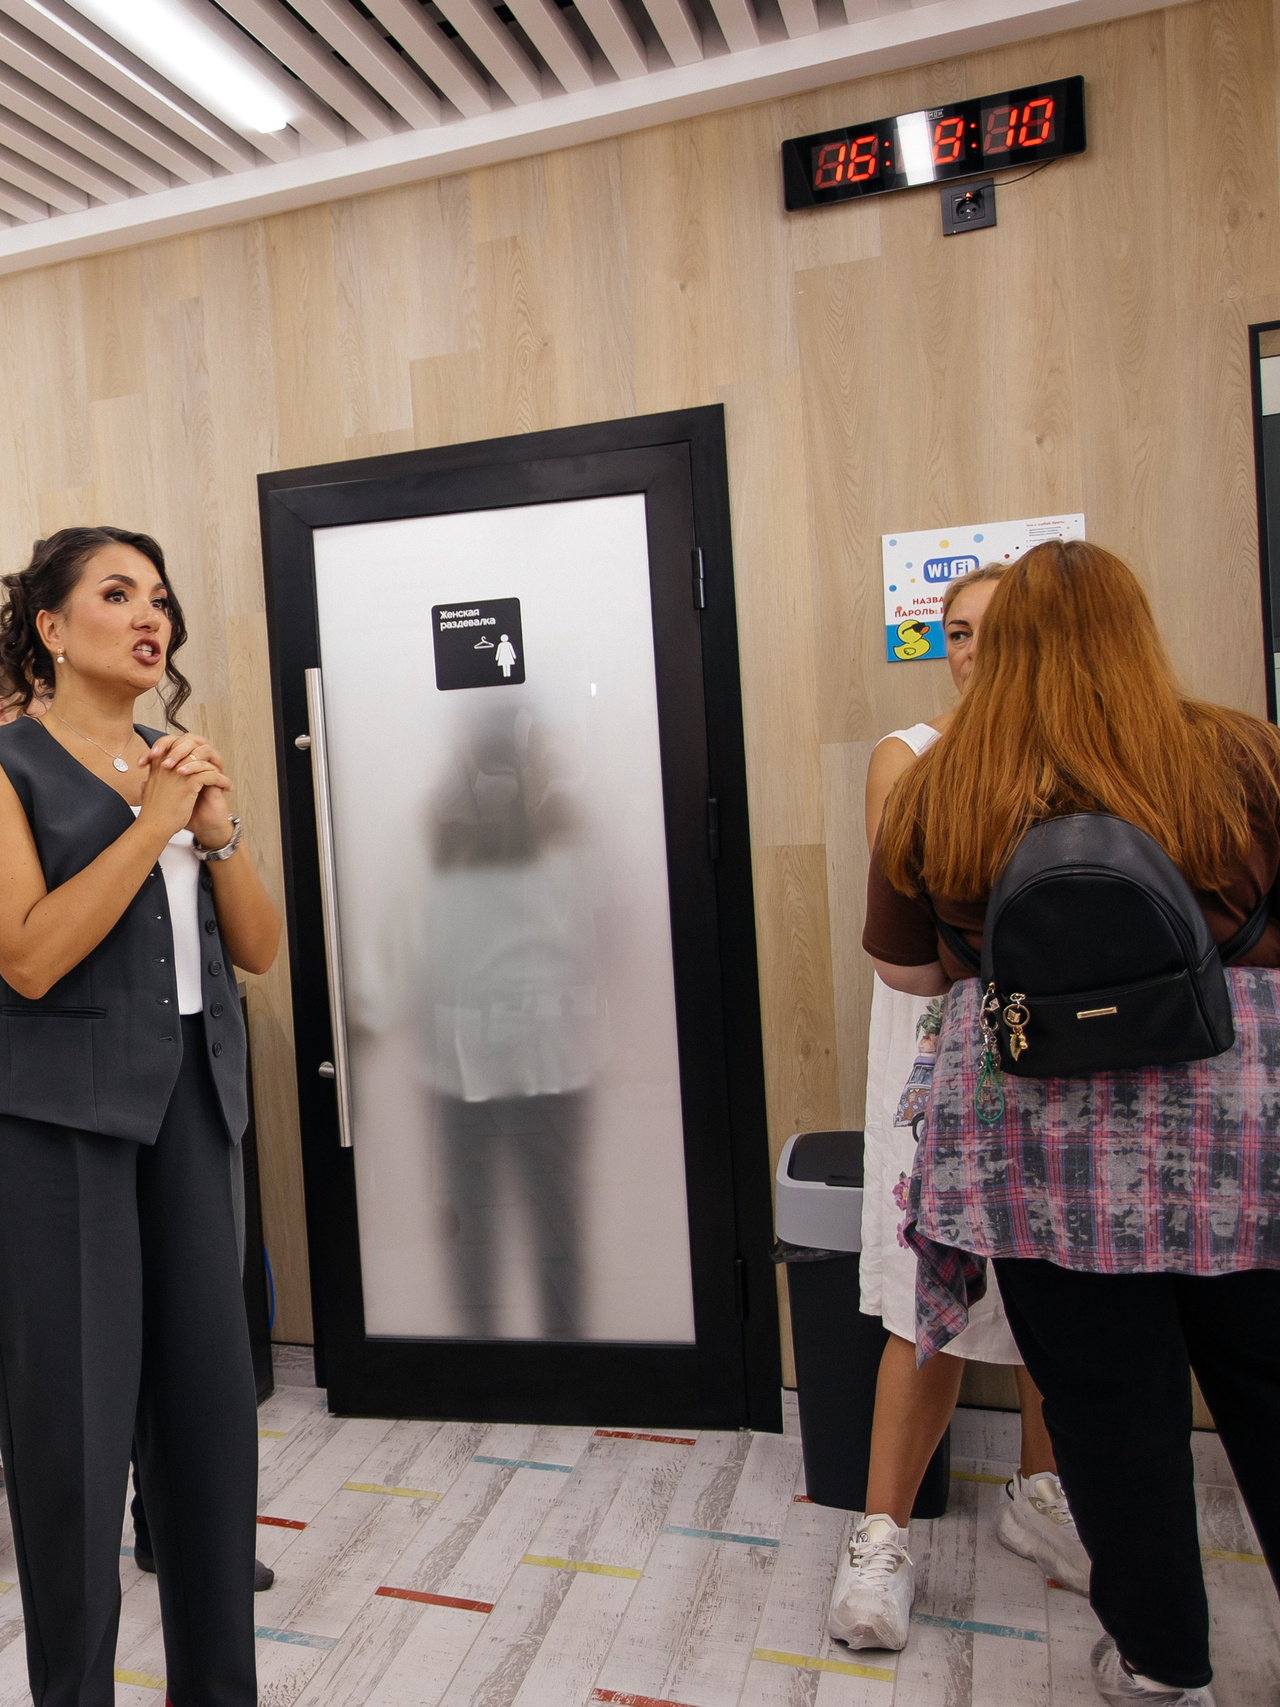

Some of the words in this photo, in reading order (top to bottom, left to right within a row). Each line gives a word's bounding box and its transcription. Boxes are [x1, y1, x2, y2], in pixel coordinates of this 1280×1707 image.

[440, 609, 480, 619] Женская
[894, 608, 938, 617] ПАРОЛЬ:
[440, 617, 496, 631] раздевалка
